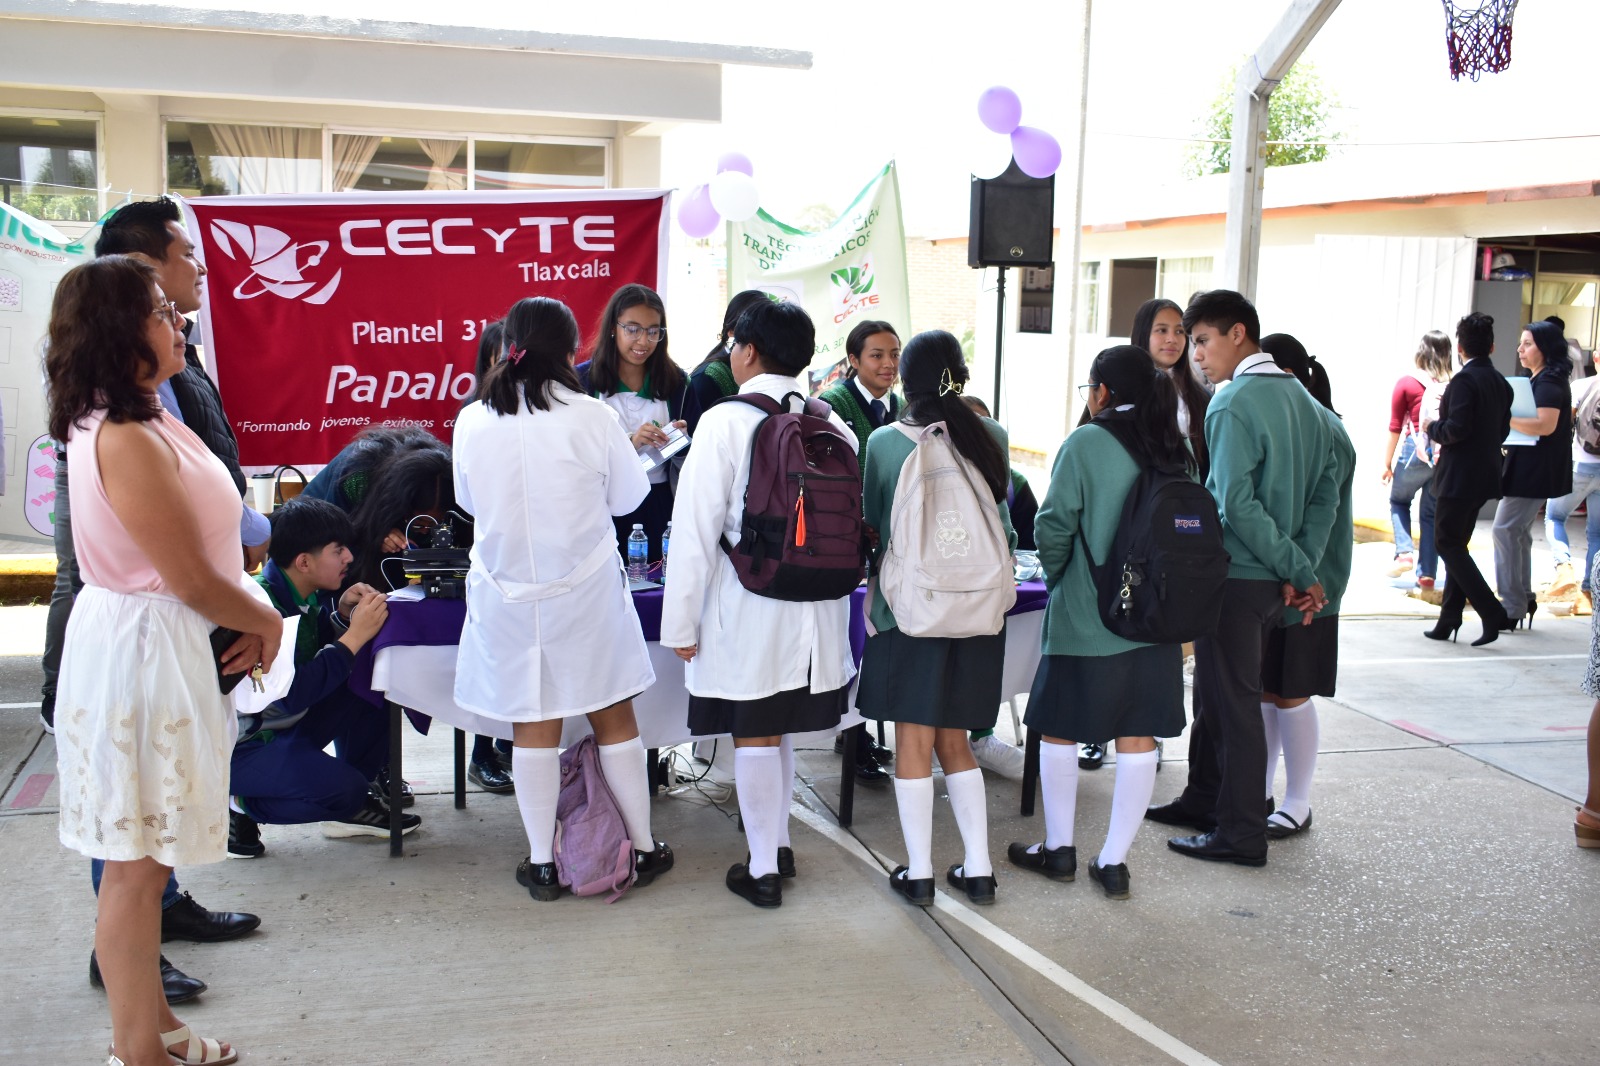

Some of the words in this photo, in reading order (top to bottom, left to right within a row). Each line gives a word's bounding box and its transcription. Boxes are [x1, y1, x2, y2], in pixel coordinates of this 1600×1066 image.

[24, 249, 68, 263] INDUSTRIAL
[518, 258, 611, 283] Tlaxcala
[352, 319, 443, 345] Plantel
[325, 363, 477, 409] Papalo
[320, 416, 371, 433] jóvenes
[382, 416, 435, 428] exitosos
